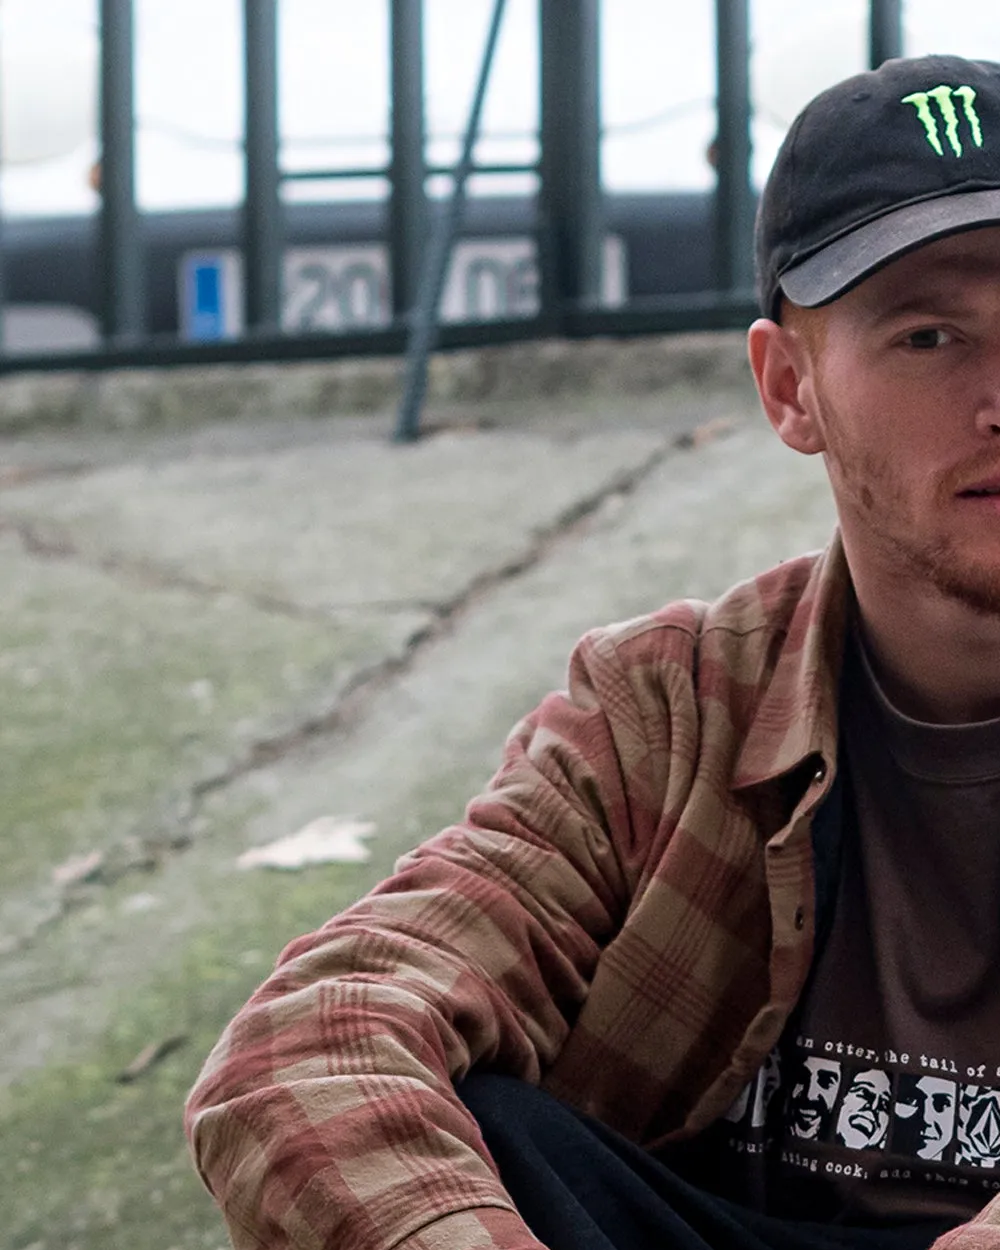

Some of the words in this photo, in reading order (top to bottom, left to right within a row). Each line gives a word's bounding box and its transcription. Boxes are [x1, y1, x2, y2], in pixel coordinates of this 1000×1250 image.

[824, 1041, 879, 1063] otter,
[920, 1054, 958, 1074] tail
[966, 1064, 986, 1078] of
